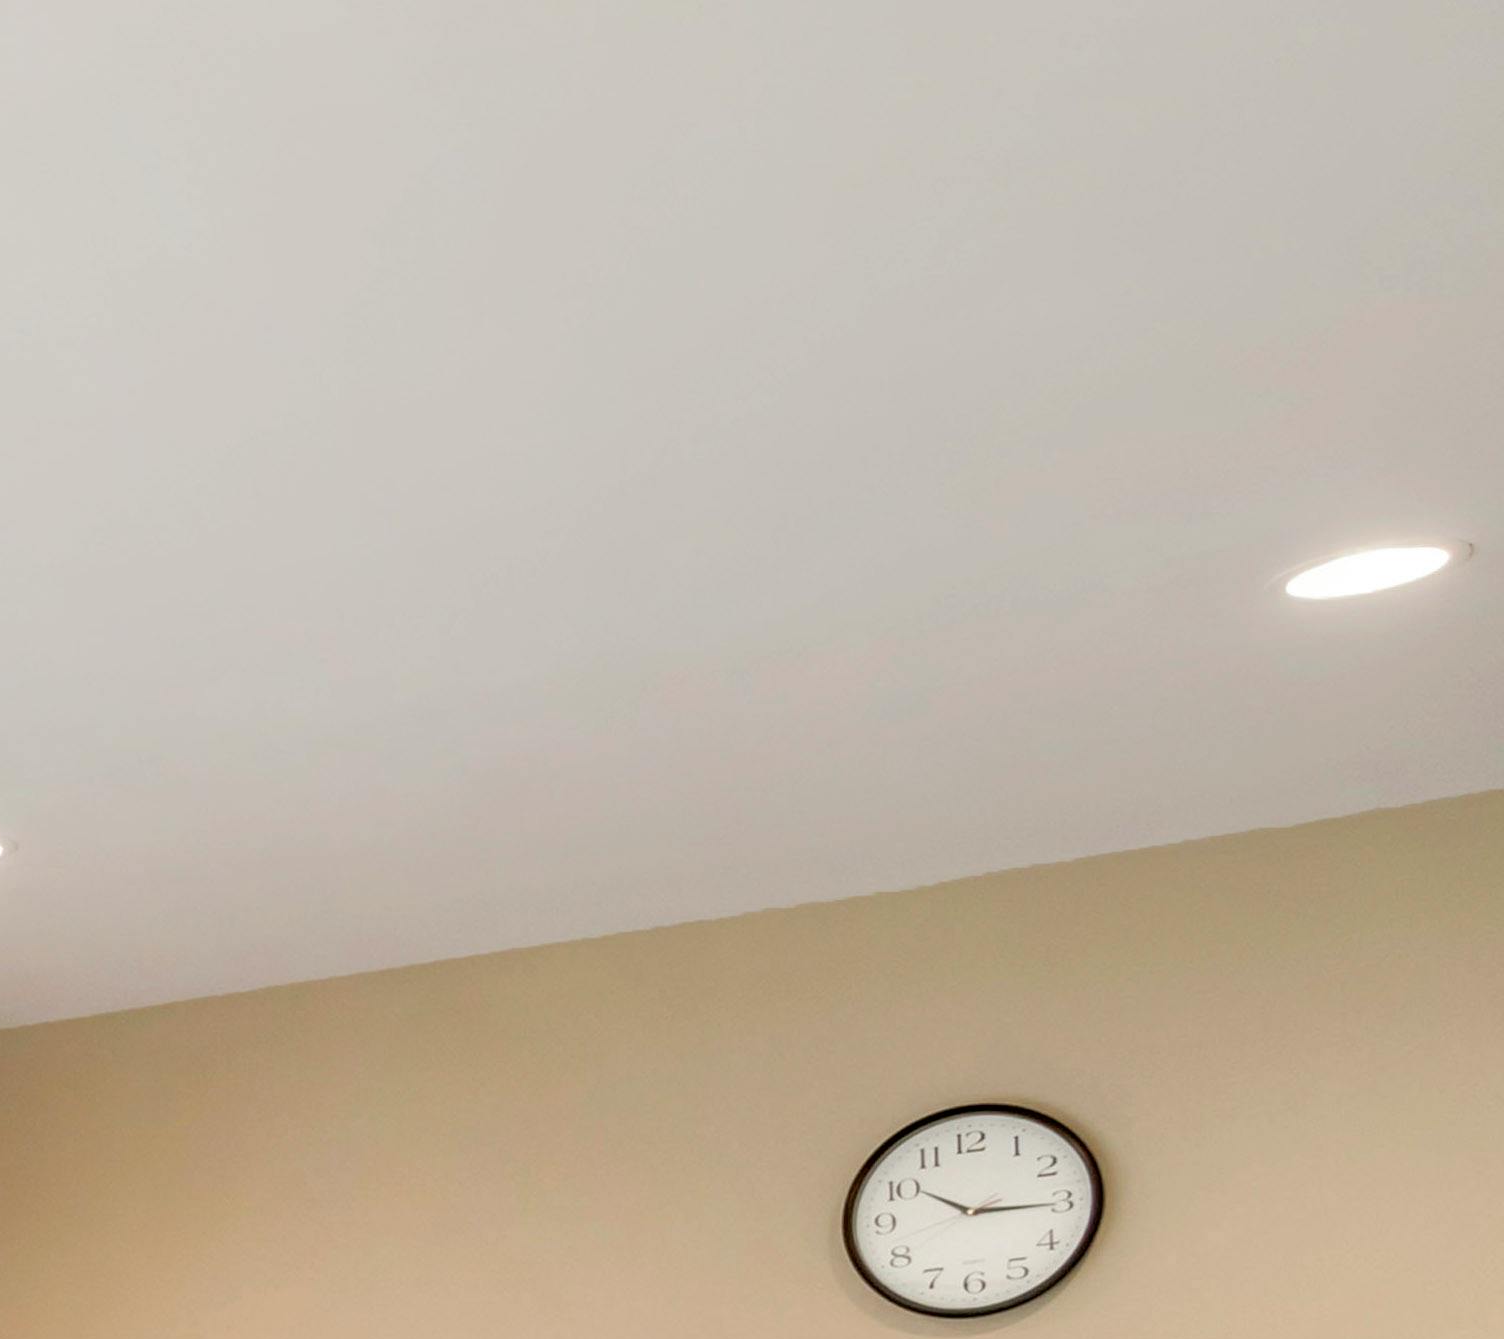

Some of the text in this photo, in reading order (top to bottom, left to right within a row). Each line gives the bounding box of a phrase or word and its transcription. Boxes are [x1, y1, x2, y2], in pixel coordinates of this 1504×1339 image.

[955, 1130, 986, 1155] 12
[1012, 1135, 1021, 1157] 1
[919, 1146, 941, 1169] 11
[1036, 1154, 1058, 1178] 2
[888, 1177, 921, 1201] 10
[1050, 1189, 1074, 1213] 3
[873, 1212, 897, 1235] 9
[1036, 1229, 1059, 1251] 4
[889, 1245, 912, 1268] 8
[1005, 1256, 1029, 1280] 5
[922, 1267, 944, 1290] 7
[963, 1271, 986, 1294] 6
